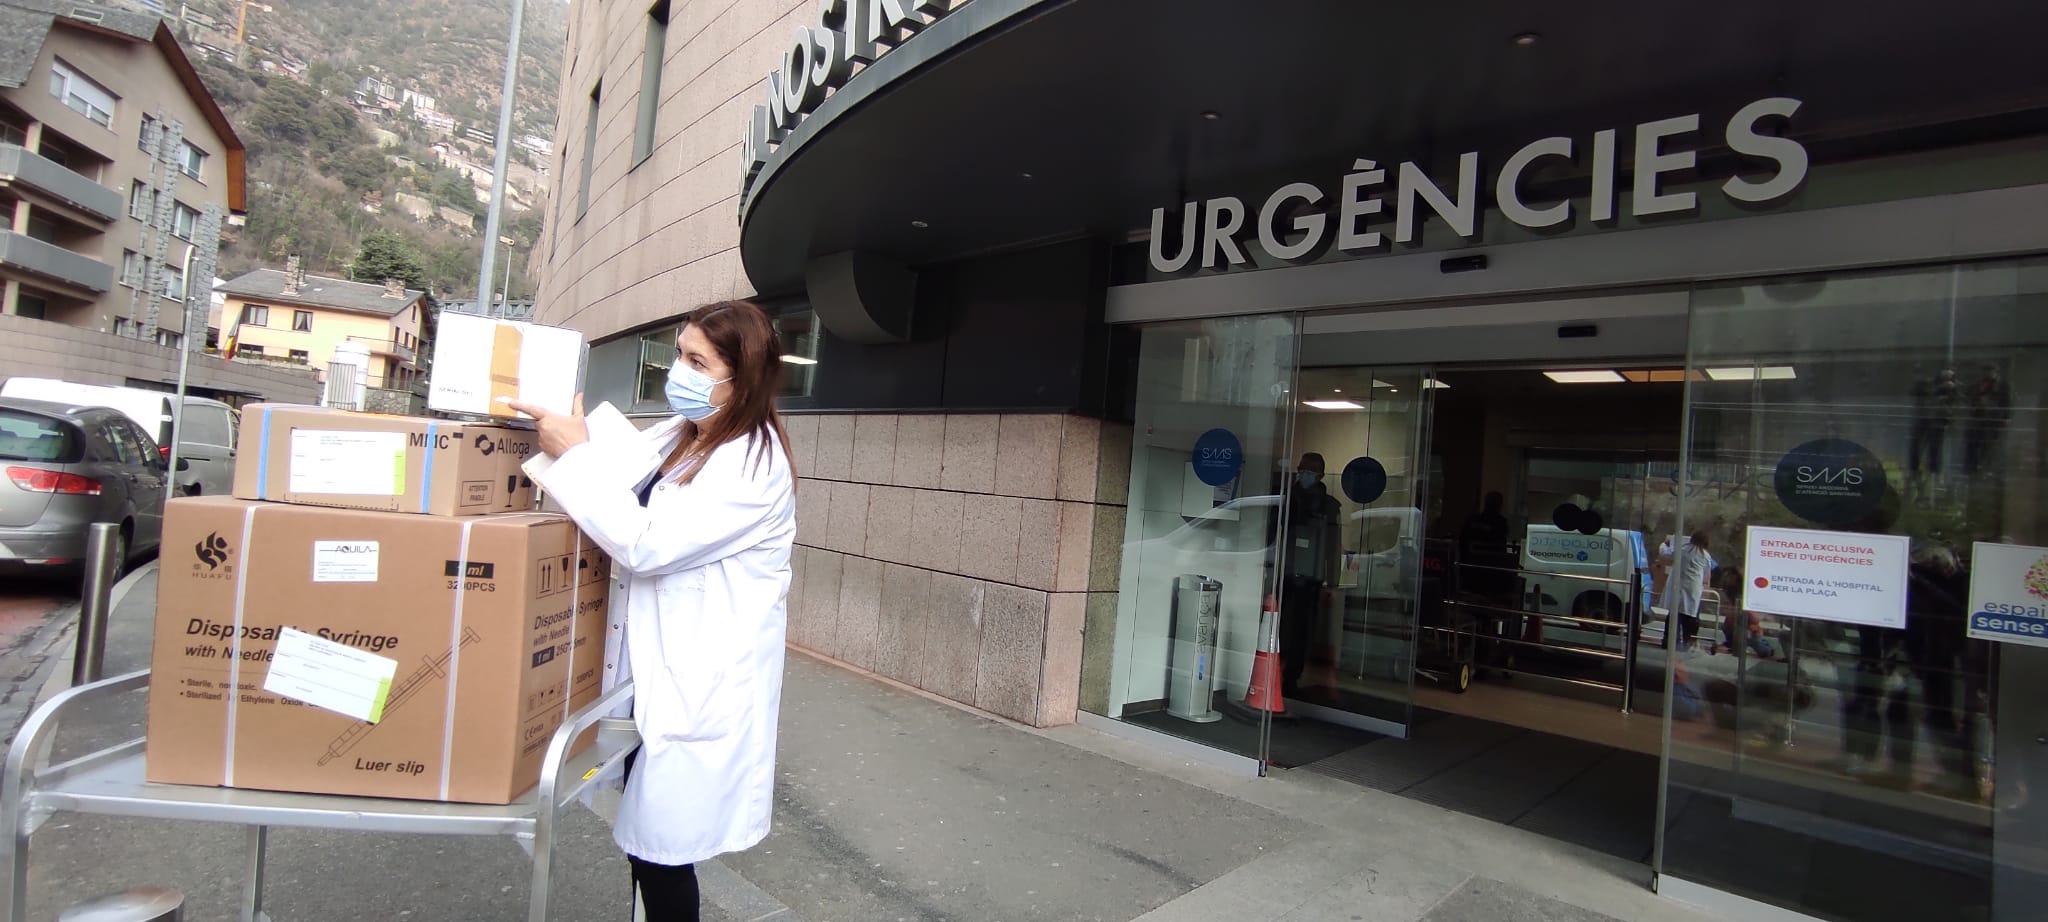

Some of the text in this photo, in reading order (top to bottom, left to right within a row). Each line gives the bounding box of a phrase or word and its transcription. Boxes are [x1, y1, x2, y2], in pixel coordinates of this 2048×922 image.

[1149, 96, 1809, 273] URGÈNCIES
[497, 438, 530, 459] Alloga
[1797, 466, 1863, 485] SAAS
[336, 545, 371, 553] AQUILA
[1760, 539, 1875, 555] ENTRADA EXCLUSIVA
[1760, 550, 1873, 566] SERVEI D'URGÈNCIES
[192, 571, 232, 580] HUAFU
[447, 580, 496, 592] 320PCS
[1771, 584, 1838, 597] PER LA PLAÇA
[1772, 575, 1815, 586] ENTRADA
[1827, 580, 1884, 592] L'HOSPITAL
[1984, 602, 2046, 617] espai
[184, 645, 216, 658] with
[241, 695, 275, 705] Ethylene
[355, 758, 425, 776] Luer slip
